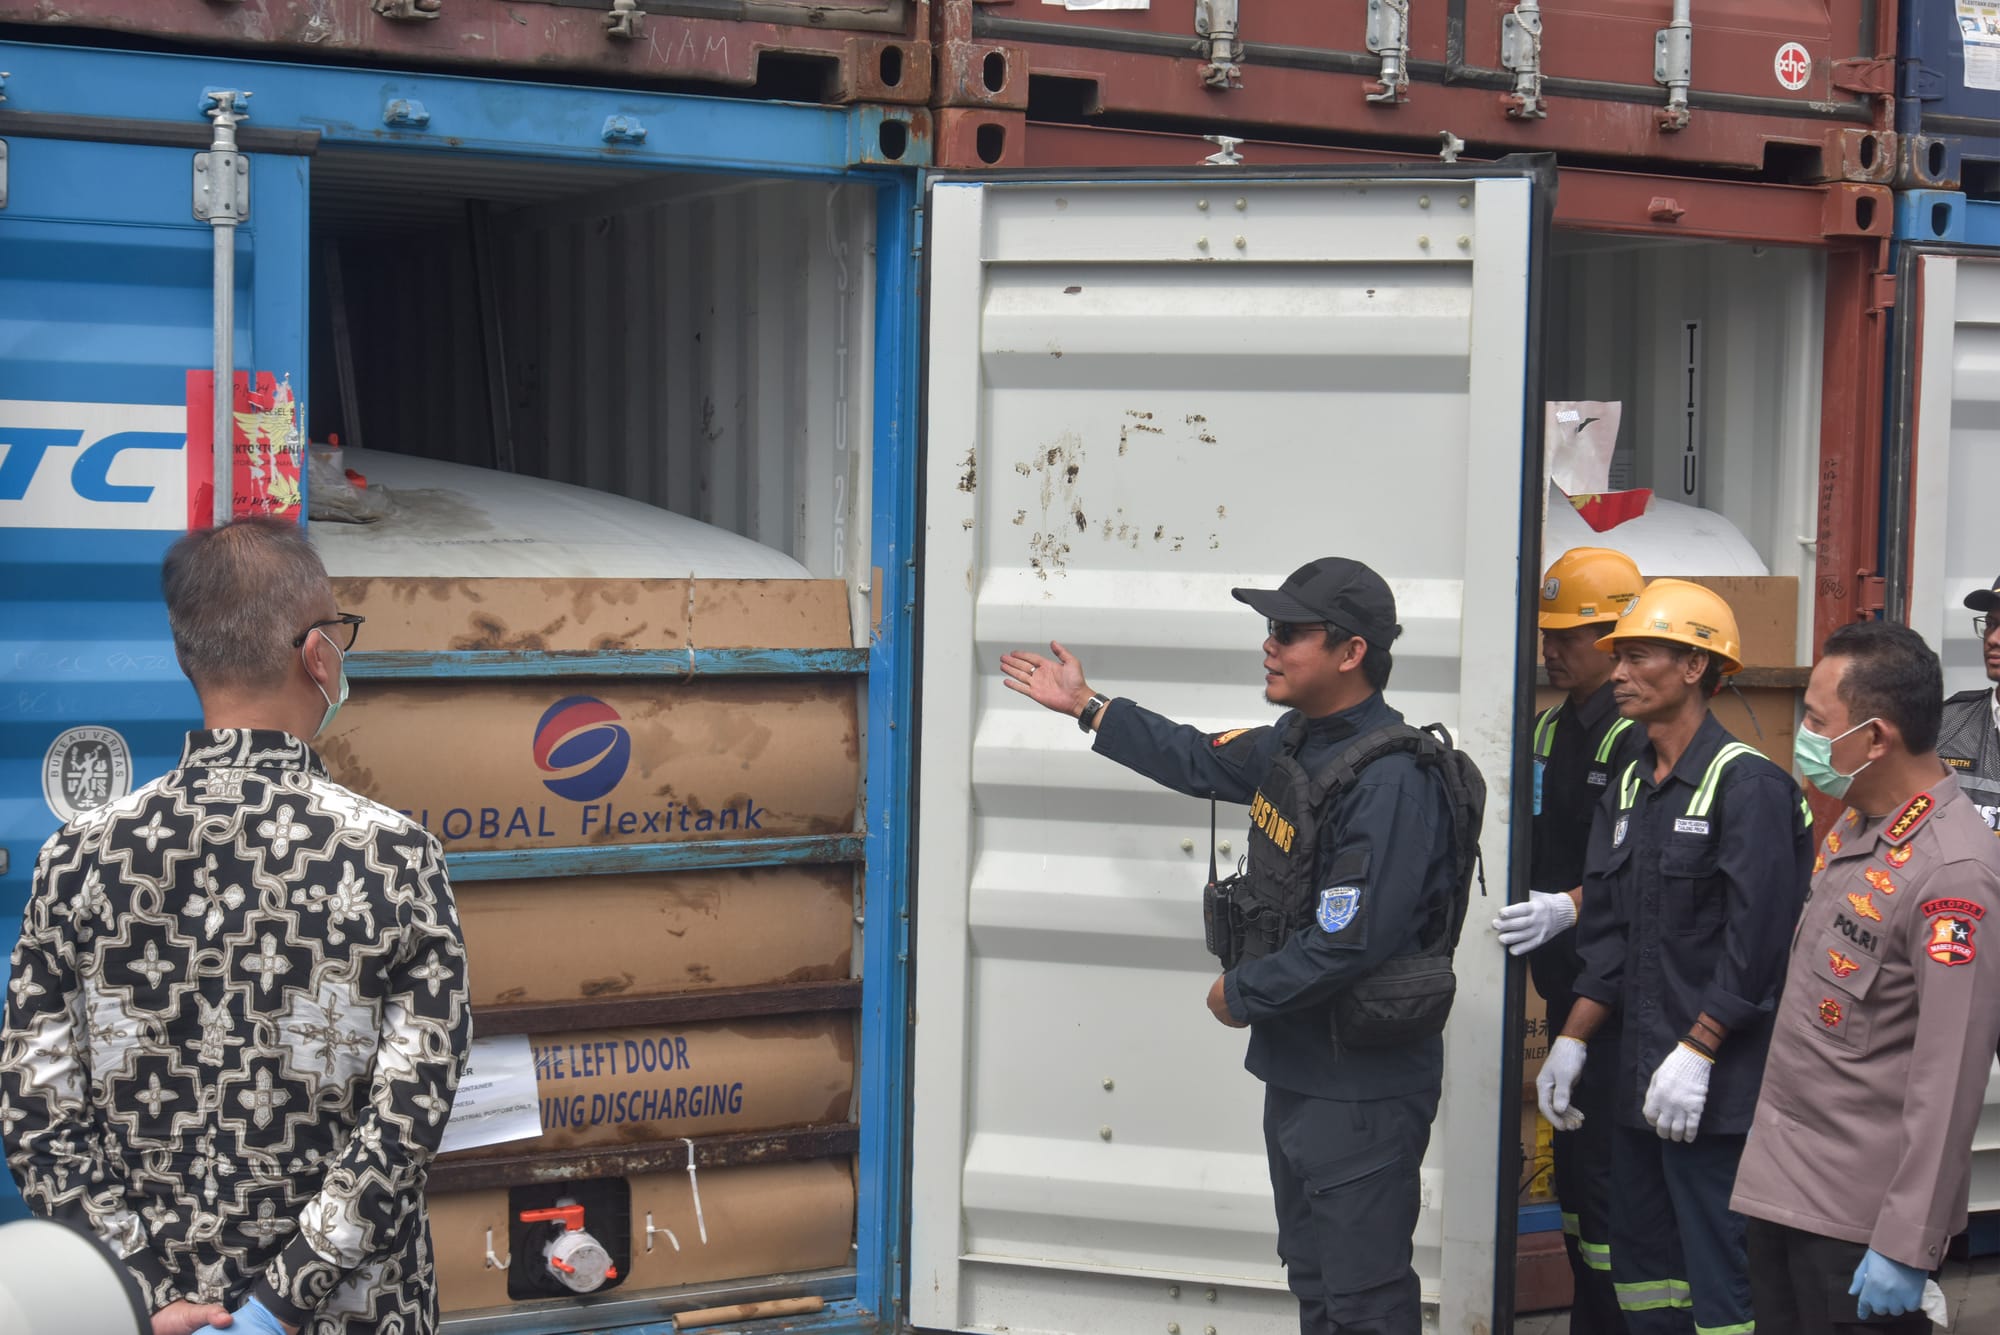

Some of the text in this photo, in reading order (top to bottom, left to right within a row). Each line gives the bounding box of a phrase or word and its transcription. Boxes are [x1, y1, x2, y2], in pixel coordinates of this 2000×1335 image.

[0, 427, 187, 503] TC
[50, 731, 124, 778] BUREAU VERITAS
[402, 800, 765, 840] LOBAL Flexitank
[1833, 913, 1878, 952] POLRI
[534, 1036, 690, 1081] HE LEFT DOOR
[539, 1082, 743, 1129] ING DISCHARGING
